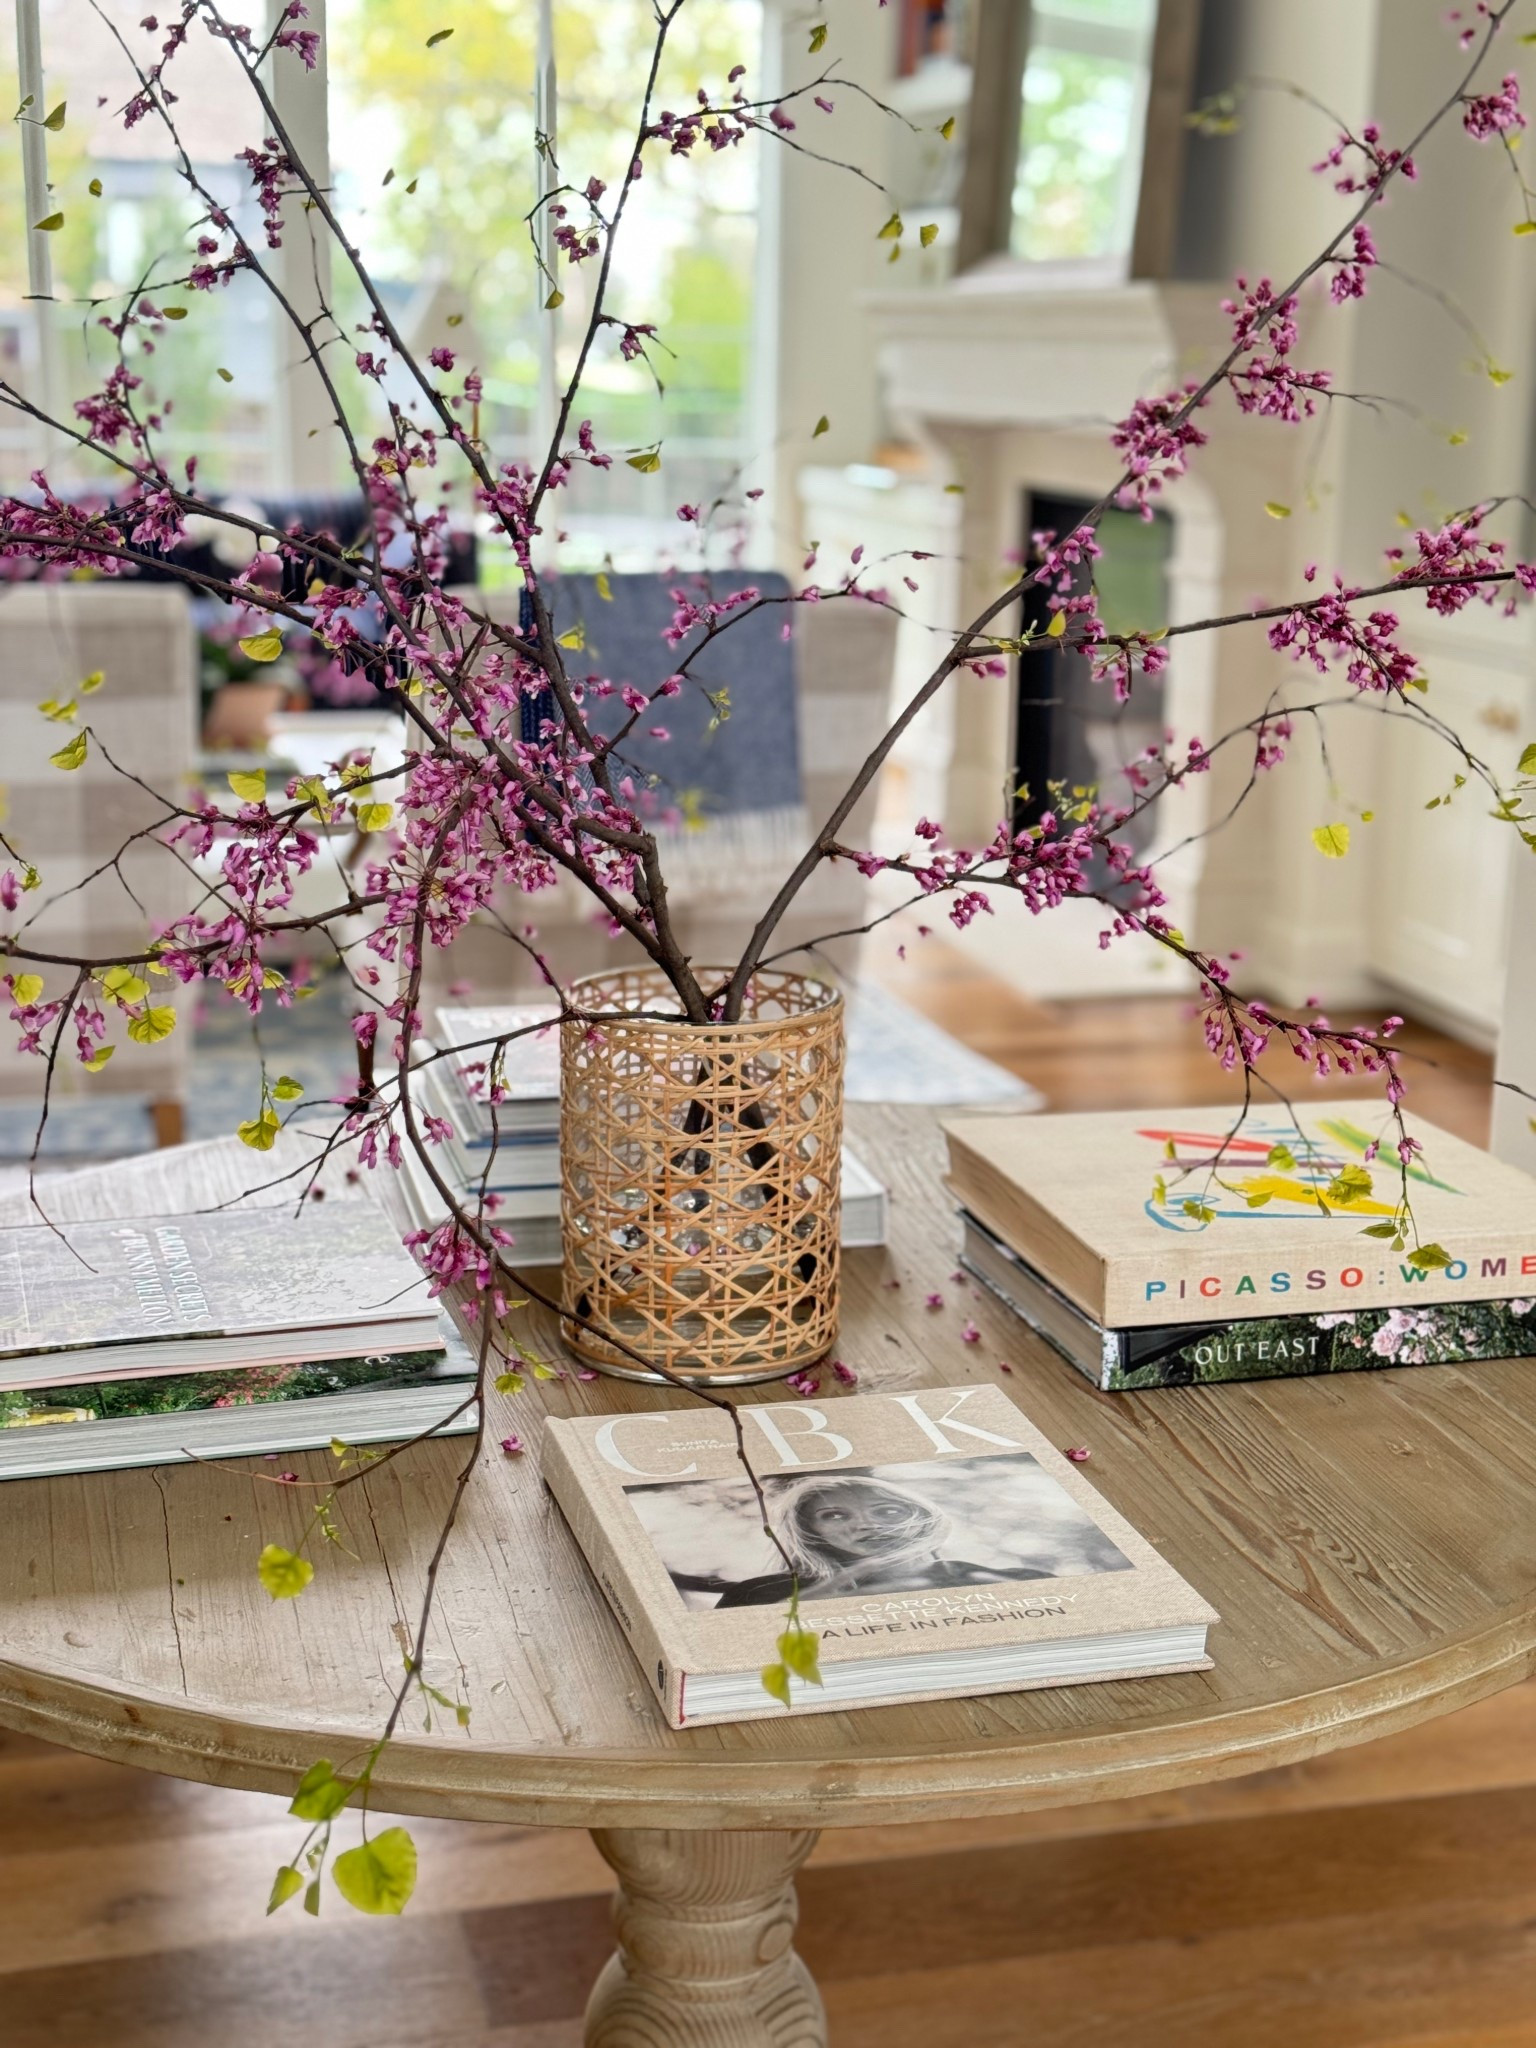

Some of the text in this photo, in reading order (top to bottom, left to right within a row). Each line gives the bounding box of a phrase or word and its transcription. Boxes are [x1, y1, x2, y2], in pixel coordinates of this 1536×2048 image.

[154, 1225, 212, 1322] GARDEN SECRETS
[131, 1276, 176, 1325] MELLON
[1195, 1336, 1319, 1365] OUT EAST
[789, 1593, 1079, 1630] BESSETTE KENNEDY
[862, 1592, 997, 1613] CAROLYN
[822, 1606, 1067, 1640] A LIFE IN FASHION
